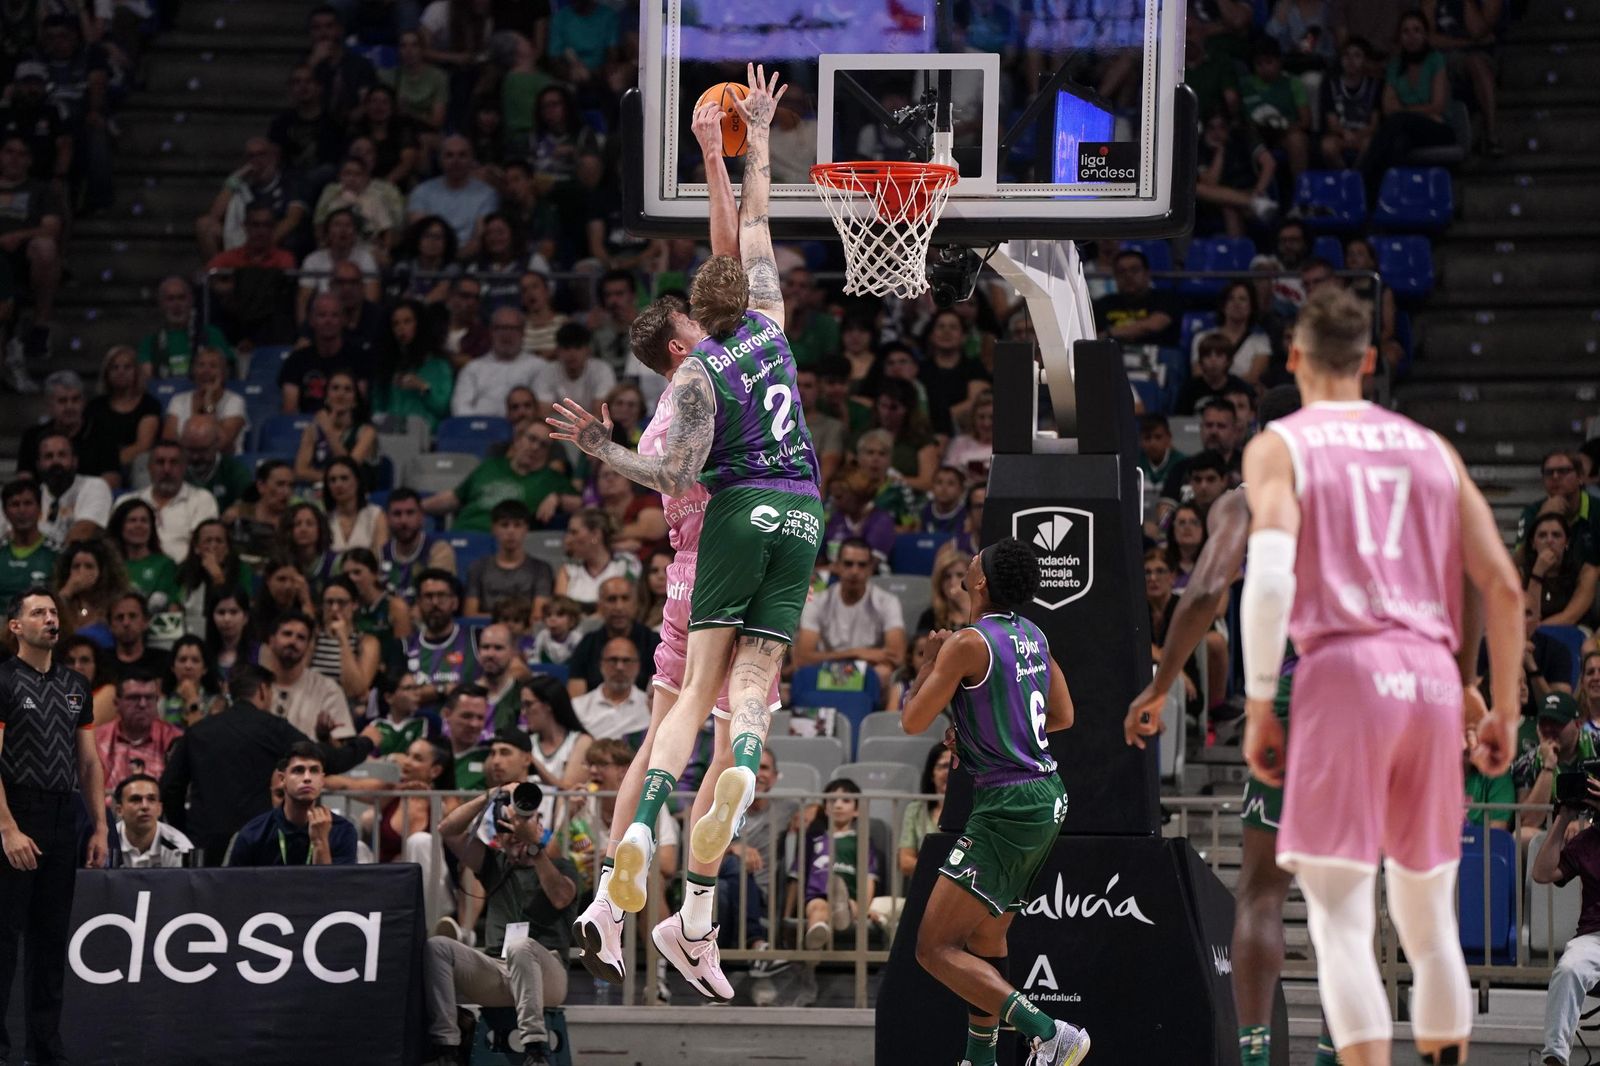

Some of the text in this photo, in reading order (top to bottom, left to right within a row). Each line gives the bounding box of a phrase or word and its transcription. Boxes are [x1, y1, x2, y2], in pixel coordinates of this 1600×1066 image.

[1080, 153, 1106, 168] liga
[1080, 166, 1135, 178] endesa
[764, 384, 796, 442] 2
[786, 509, 819, 530] COSTA
[1346, 462, 1412, 559] 17
[781, 527, 817, 548] MÁLAGA
[784, 518, 818, 539] DEL SOL
[1036, 554, 1080, 566] ndación
[1040, 567, 1073, 580] nicaja
[1009, 635, 1040, 659] Taylor
[1030, 690, 1049, 750] 6
[1021, 871, 1156, 926] alucía
[68, 890, 382, 985] desa
[1028, 992, 1082, 1002] de Andalucía
